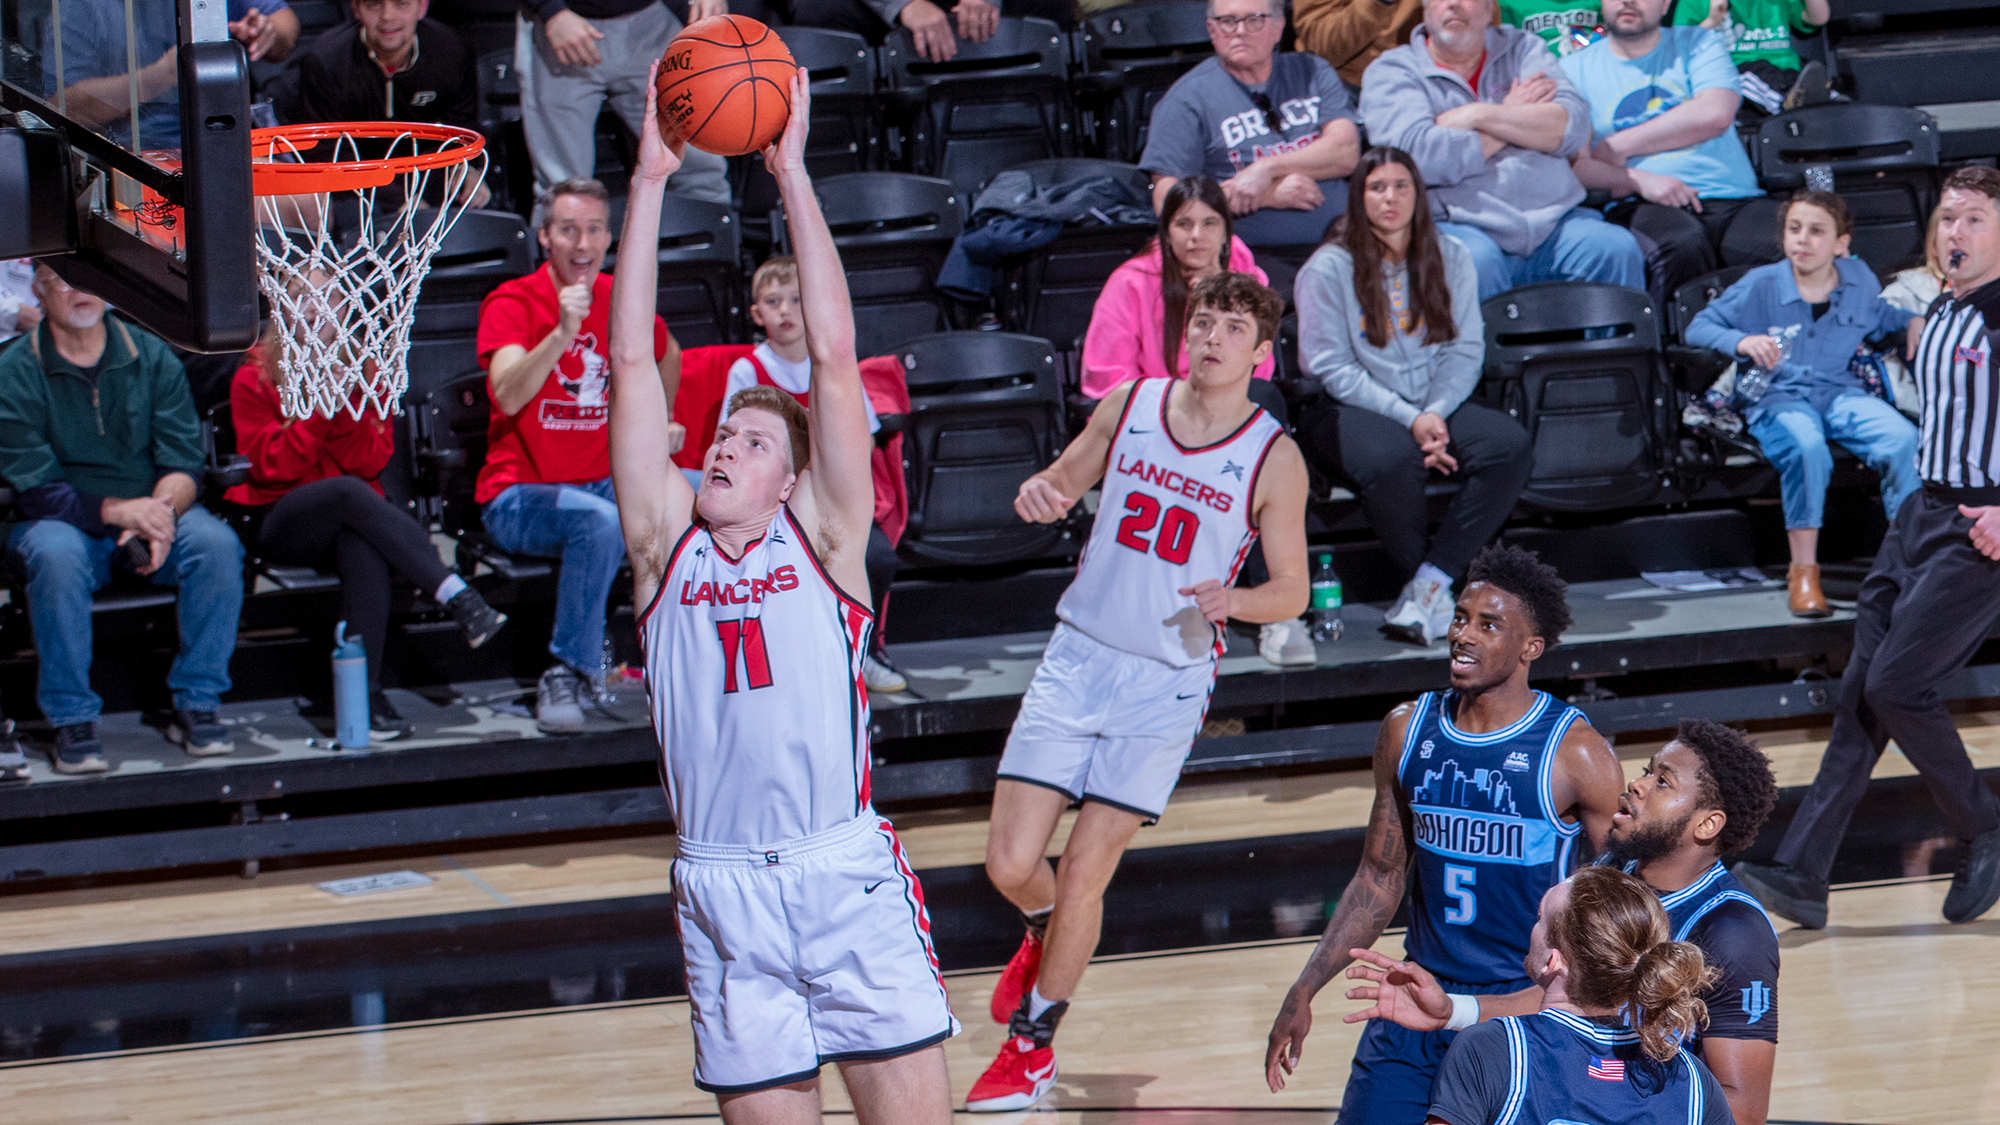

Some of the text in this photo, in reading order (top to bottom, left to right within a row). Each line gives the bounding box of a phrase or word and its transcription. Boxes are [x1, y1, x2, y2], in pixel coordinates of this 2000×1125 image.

[496, 64, 507, 79] 7
[1221, 96, 1321, 148] GRC
[1789, 122, 1799, 137] 1
[1507, 303, 1519, 319] 3
[1117, 453, 1234, 514] LANCERS
[1115, 490, 1200, 567] 20
[680, 564, 799, 607] LANCERS
[715, 613, 774, 695] 11
[1412, 809, 1525, 860] JOHNSON
[1443, 862, 1477, 926] 5
